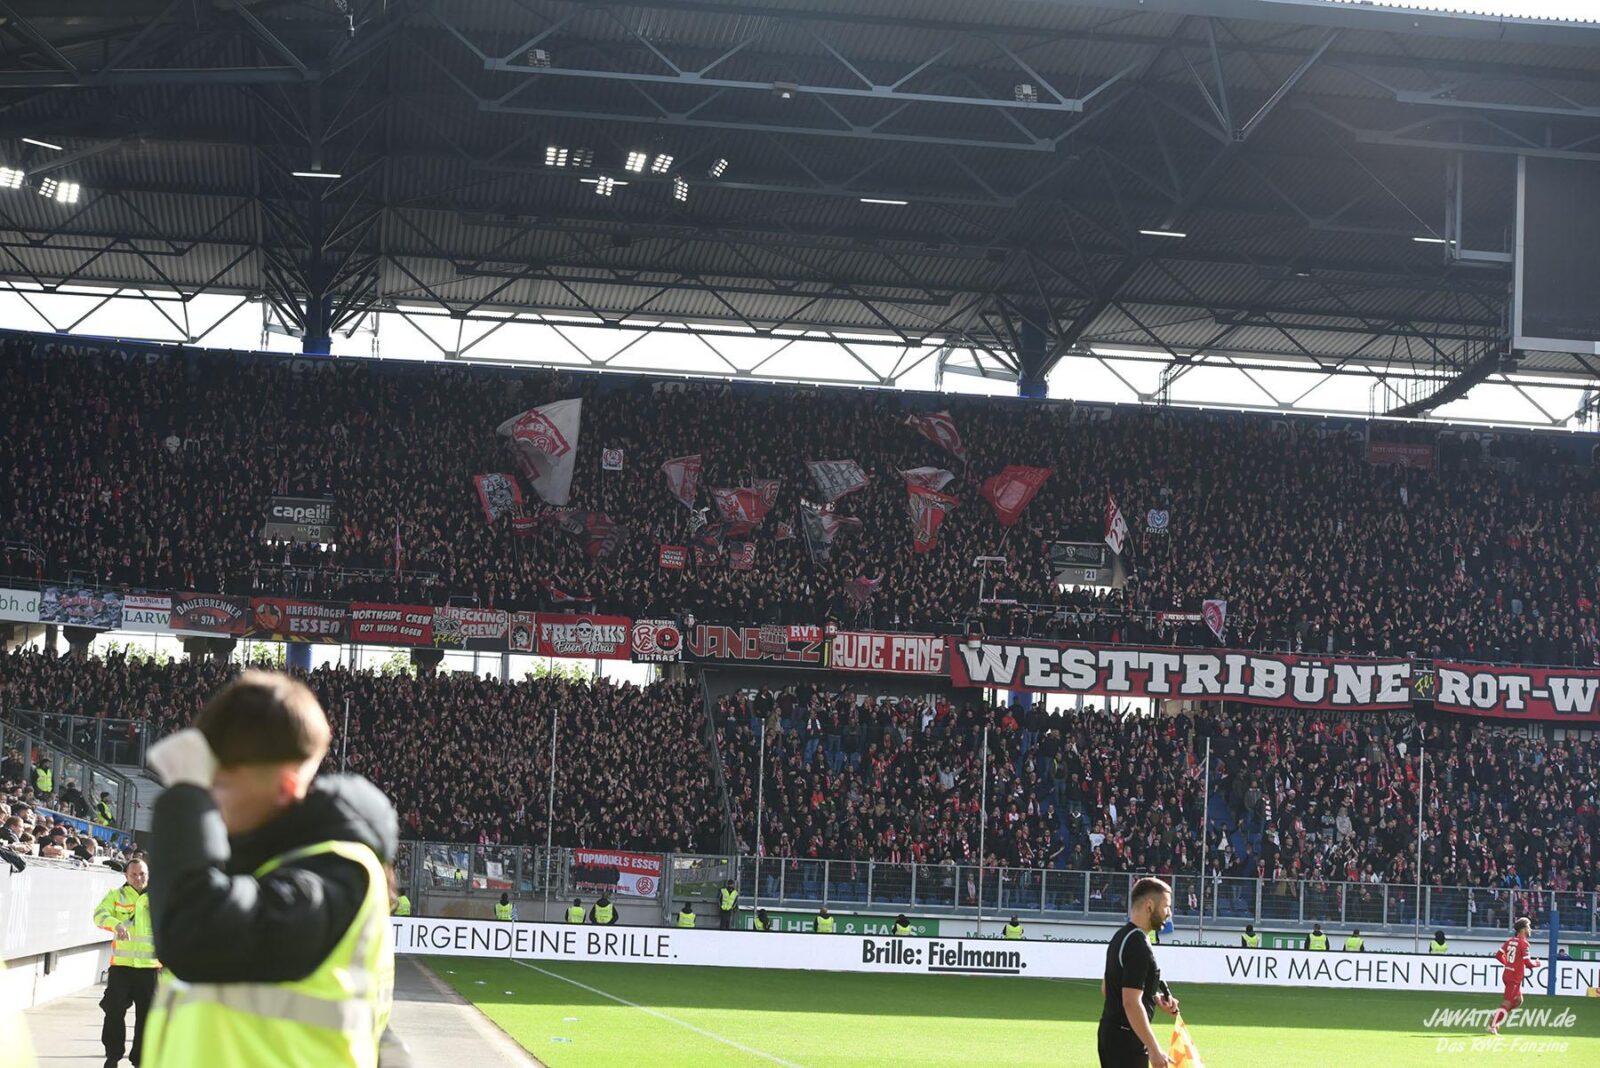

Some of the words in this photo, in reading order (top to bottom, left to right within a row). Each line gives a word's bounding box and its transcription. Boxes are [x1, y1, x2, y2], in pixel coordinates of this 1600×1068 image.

[273, 504, 331, 522] capelli
[1086, 570, 1096, 579] 21
[176, 598, 243, 619] DAUERBRENNER
[289, 618, 341, 635] ESSEN
[352, 610, 403, 622] NORTHSIDE
[405, 613, 432, 626] CREW
[360, 623, 374, 632] ROT
[461, 624, 503, 636] CREW
[541, 623, 627, 644] FREAKS
[790, 625, 820, 637] RVT
[554, 640, 582, 654] Essen
[832, 635, 885, 668] RUDE
[890, 635, 945, 672] FANS
[637, 653, 675, 662] ULTRAS
[959, 643, 1410, 704] WESTTRIBÜNE
[1437, 667, 1600, 713] ROT-W
[631, 858, 660, 871] ESSEN
[410, 925, 577, 954] IRGENDEINE
[587, 931, 679, 959] BRILLE.
[862, 938, 922, 967] Brille:
[928, 941, 1027, 969] Fielmann.
[1225, 954, 1279, 979] WIR
[1288, 957, 1411, 985] MACHEN
[1420, 961, 1504, 988] NICHT
